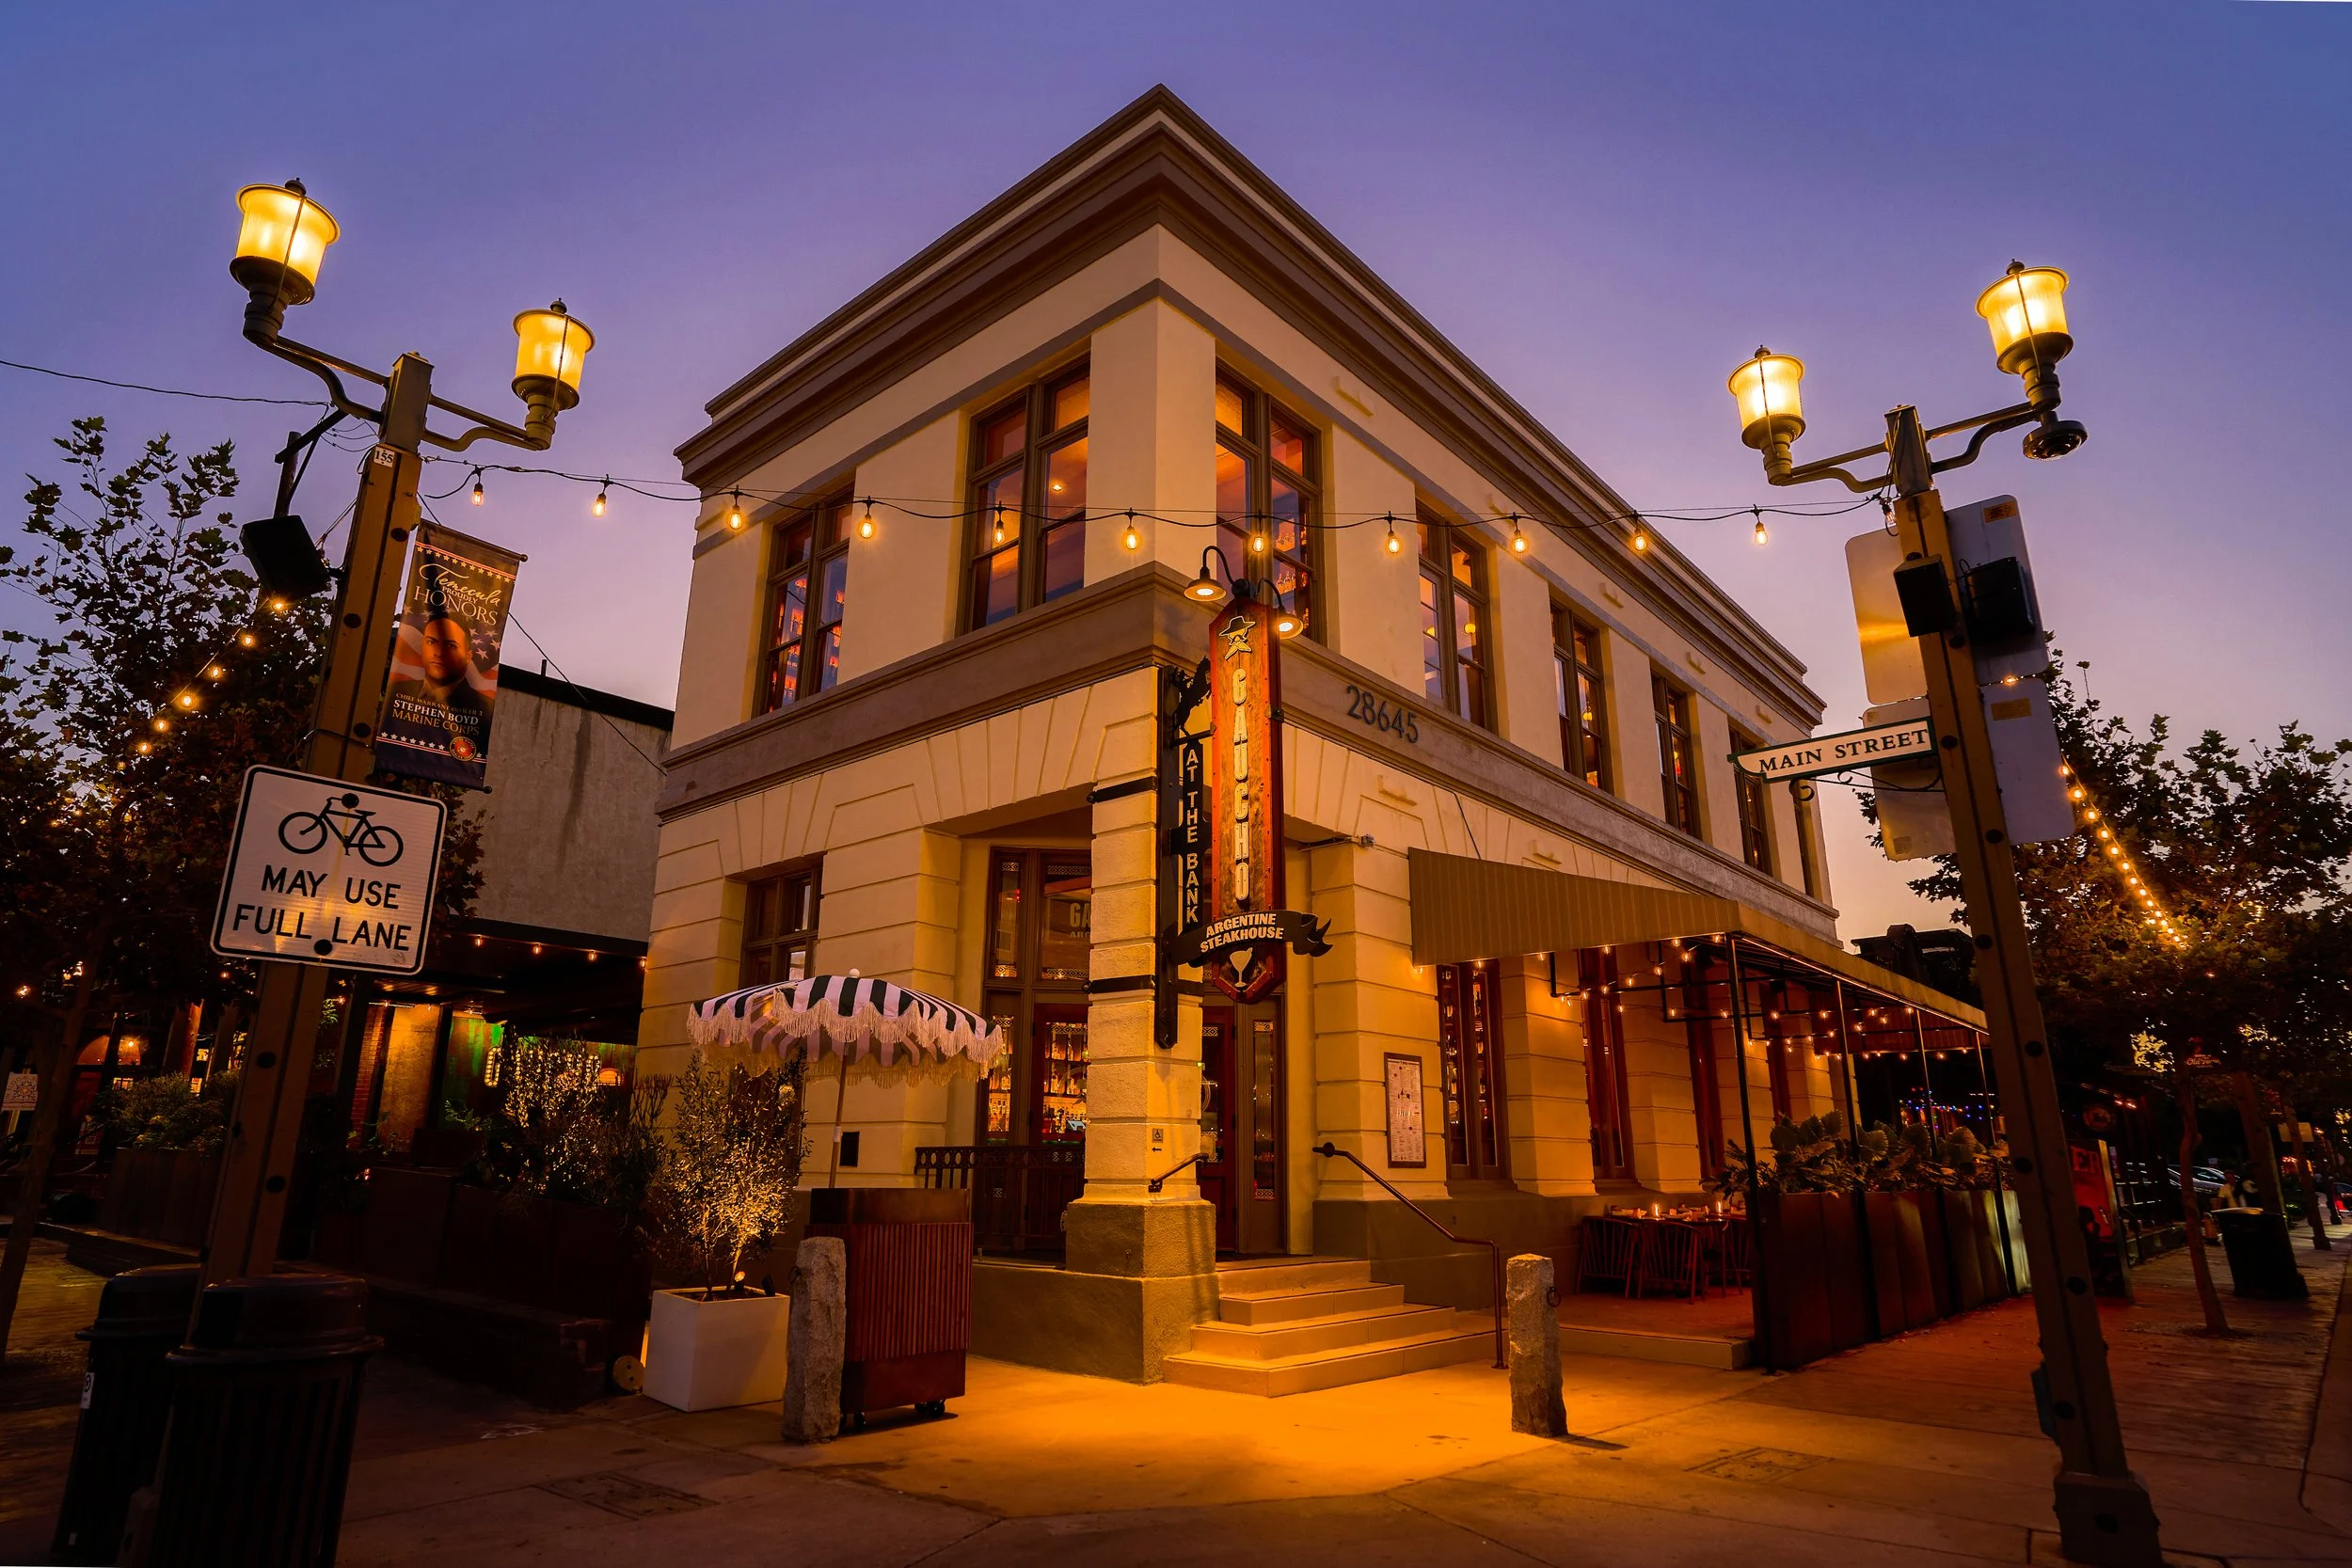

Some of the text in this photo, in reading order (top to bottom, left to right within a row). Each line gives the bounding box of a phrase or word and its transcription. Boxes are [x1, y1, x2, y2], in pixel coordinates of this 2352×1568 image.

[375, 451, 393, 463] 155
[414, 585, 499, 626] HONORS
[419, 563, 501, 607] Temecula
[442, 586, 479, 604] PROUDLY
[391, 708, 480, 736] MARINE CORPS
[393, 699, 479, 725] STEPHEN BOYD
[1346, 684, 1419, 744] 28645
[1758, 728, 1928, 773] MAIN STREET
[1232, 669, 1249, 901] GAUCHO
[1185, 750, 1200, 924] AT THE BANK
[261, 864, 402, 910] MAY USE
[232, 903, 412, 952] FULL LANE
[1200, 927, 1284, 953] STEAKHOUSE
[1205, 913, 1277, 939] ARGENTINE
